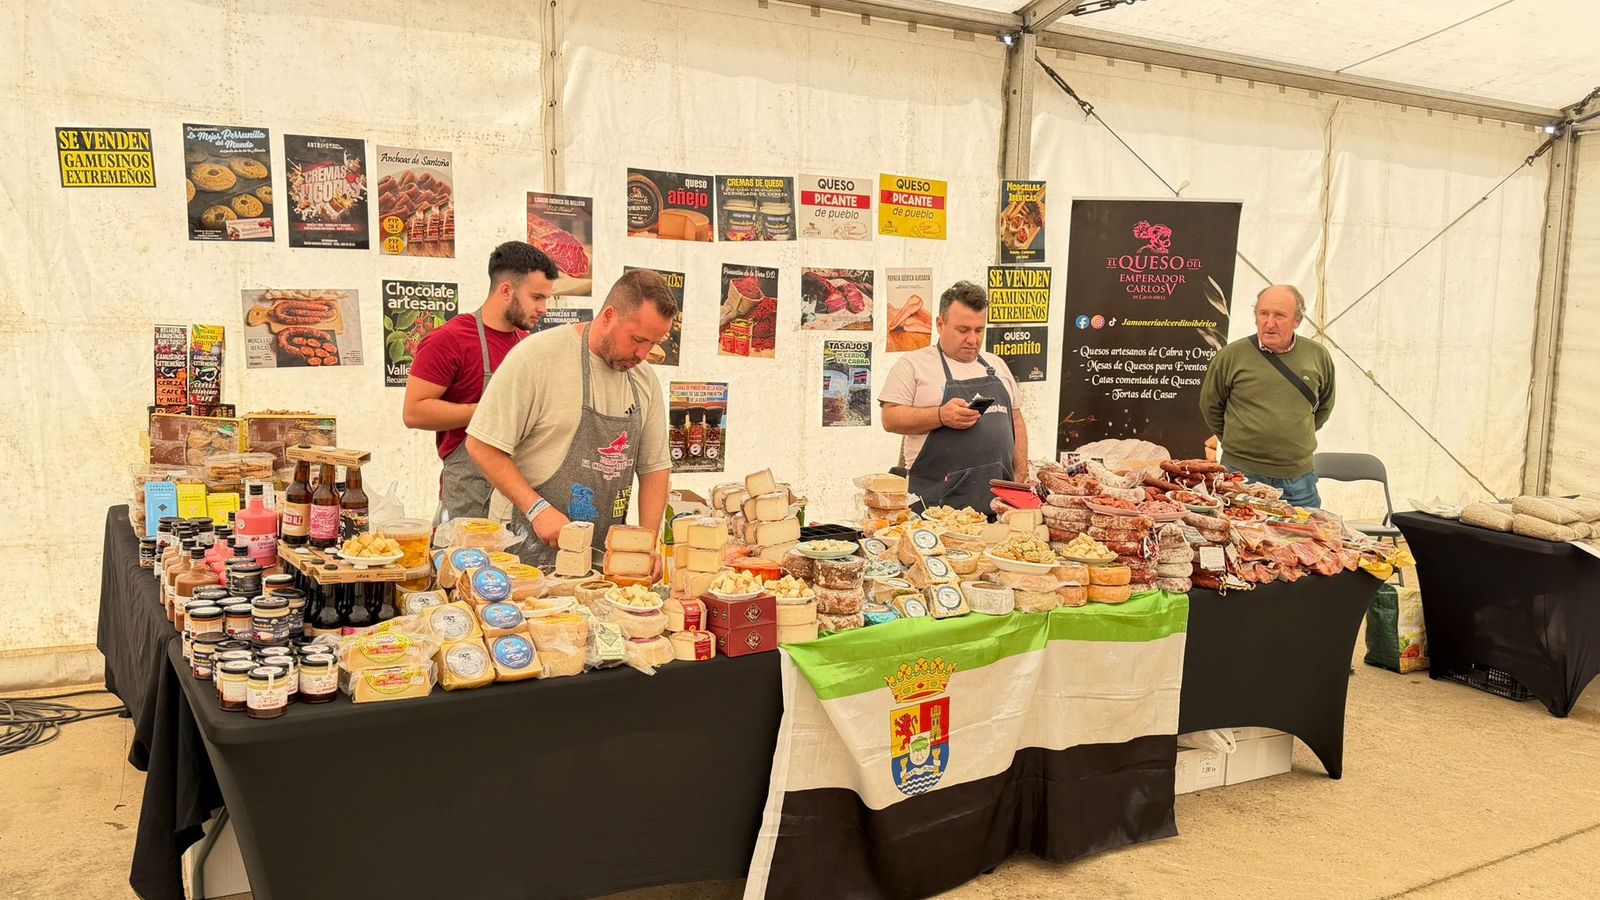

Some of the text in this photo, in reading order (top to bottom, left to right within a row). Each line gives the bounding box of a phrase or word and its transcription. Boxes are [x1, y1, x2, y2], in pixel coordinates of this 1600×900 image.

[59, 131, 149, 150] SE VENDEN
[197, 132, 221, 142] Mejor
[221, 129, 266, 139] Perrunilla
[225, 140, 254, 148] Mundo
[64, 154, 150, 168] GAMUSINOS
[381, 152, 450, 167] Anchoas de Santoña
[66, 168, 150, 184] EXTREMEÑOS
[304, 165, 347, 182] CREMAS
[685, 179, 707, 188] queso
[727, 178, 783, 189] CREMAS DE QUESO
[818, 178, 855, 191] QUESO
[896, 179, 930, 192] QUESO
[1007, 182, 1041, 191] MORCILLAS
[668, 188, 708, 209] añejo
[815, 194, 857, 206] PICANTE
[892, 193, 933, 207] PICANTE
[815, 208, 859, 219] de pueblo
[892, 207, 934, 219] de pueblo
[1108, 255, 1202, 272] EL QUESO DEL
[990, 269, 1050, 288] SE VENDEN
[1120, 274, 1186, 283] EMPERADOR
[386, 282, 454, 298] Chocolate
[1126, 284, 1176, 296] CARLOS V
[388, 296, 456, 311] artesano
[992, 290, 1046, 304] GAMUSINOS
[991, 305, 1045, 320] EXTREMEÑOS
[1004, 332, 1031, 340] QUESO
[994, 341, 1041, 356] picantito
[1080, 346, 1109, 358] Quesos
[1111, 348, 1146, 356] artesanos
[1148, 348, 1157, 356] de
[1159, 347, 1183, 358] Cabra
[1186, 350, 1191, 360] y
[387, 364, 410, 375] Valle
[1087, 360, 1112, 372] Mesas
[1114, 362, 1122, 370] de
[1125, 361, 1154, 373] Quesos
[1156, 363, 1172, 373] para
[1175, 362, 1207, 371] Eventos
[1092, 375, 1114, 386] Catas
[1116, 376, 1158, 385] comentadas
[1160, 377, 1169, 385] de
[1171, 377, 1201, 388] Quesos
[1112, 389, 1139, 400] Tortas
[1141, 389, 1151, 398] del
[1153, 390, 1177, 400] Casar
